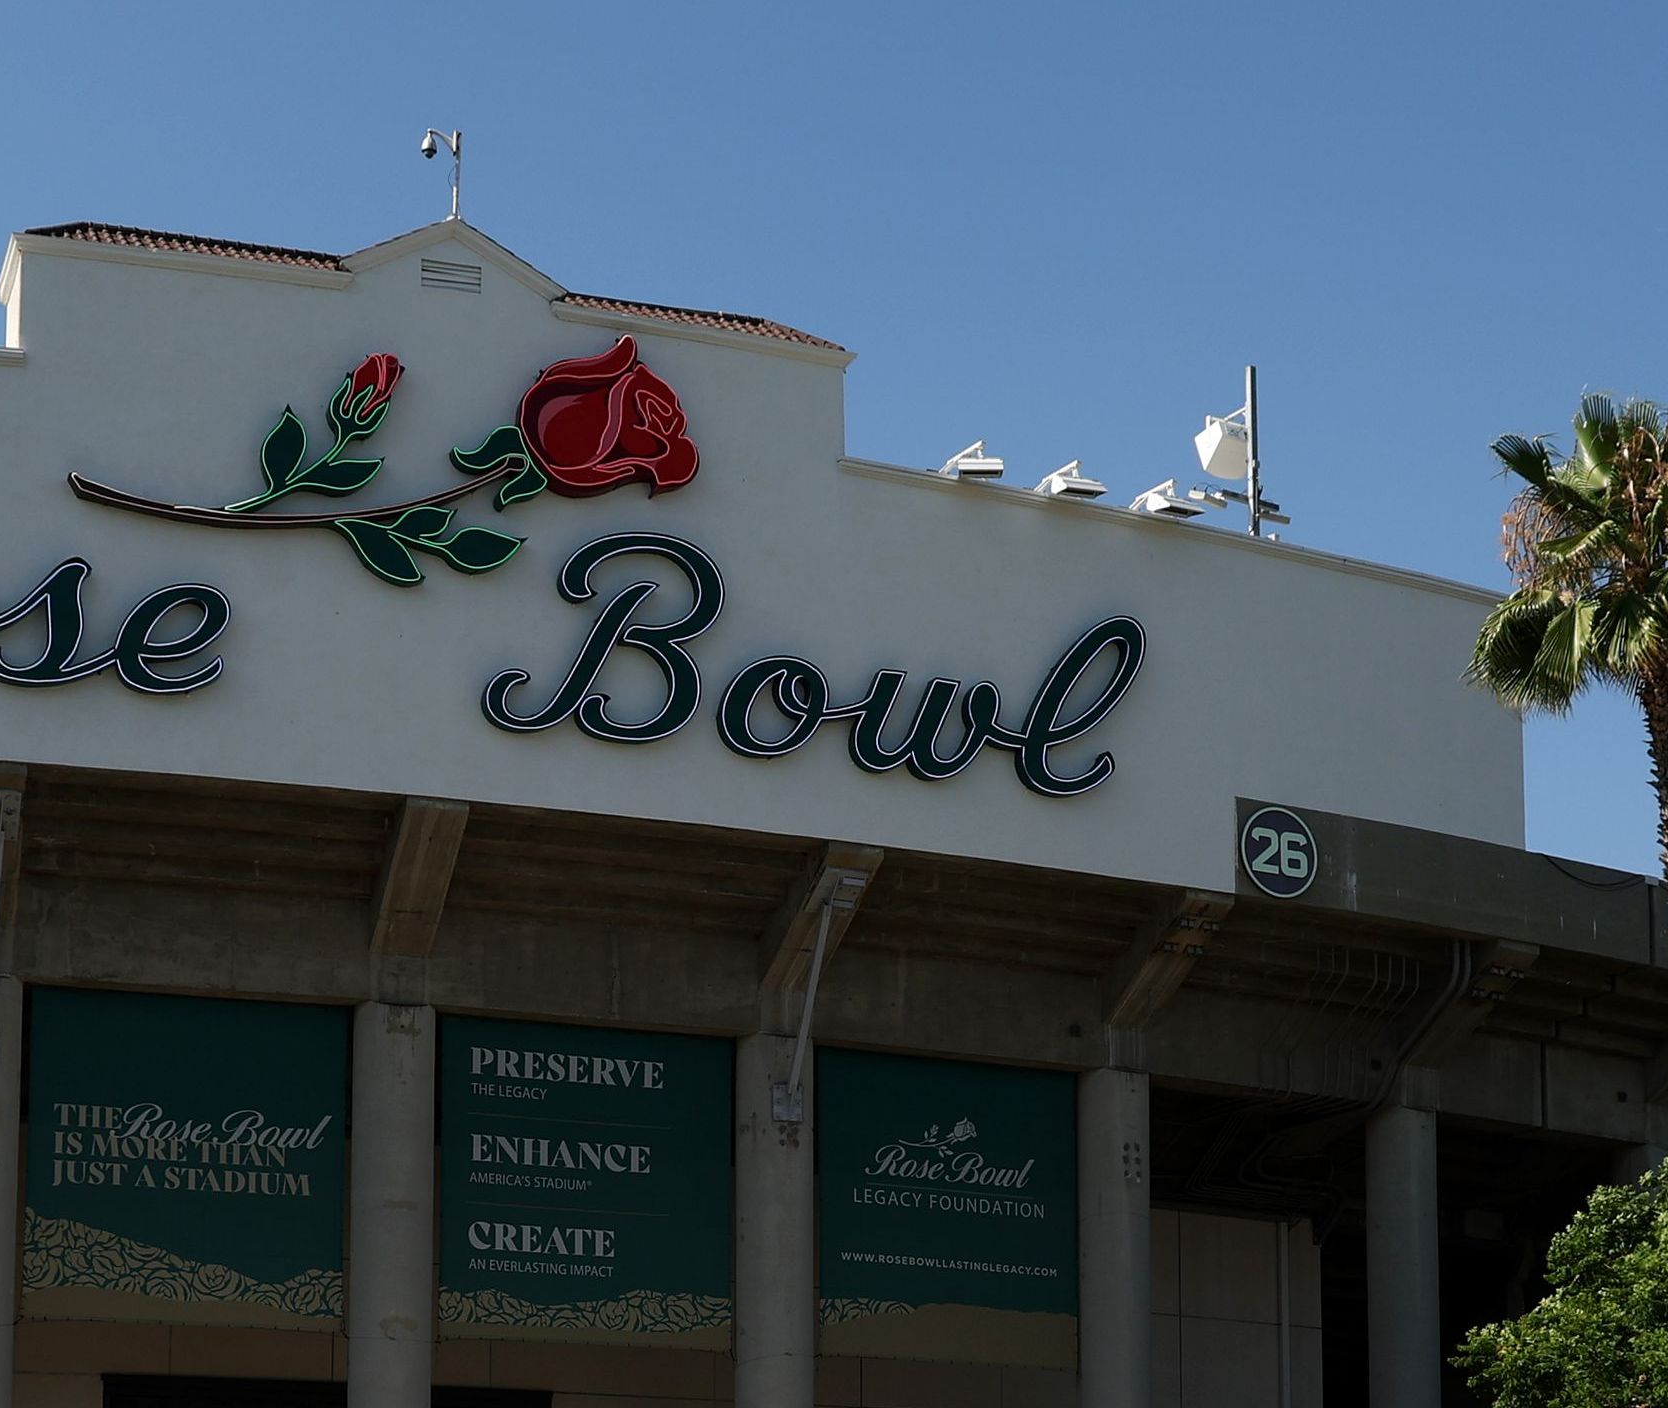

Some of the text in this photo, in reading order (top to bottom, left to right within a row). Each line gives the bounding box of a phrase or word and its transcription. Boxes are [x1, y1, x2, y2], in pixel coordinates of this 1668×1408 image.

[481, 531, 1147, 798] Bowl
[1252, 827, 1308, 878] 26
[470, 1046, 664, 1089] PRESERVE
[471, 1083, 547, 1100] THE LEGACY
[53, 1102, 332, 1150] THE Rose Bowl
[53, 1130, 286, 1168] IS MORE THAN
[470, 1133, 651, 1174] ENHANCE
[865, 1144, 1035, 1189] Rose Bowl
[52, 1159, 311, 1197] JUST A STADIUM
[469, 1172, 531, 1187] AMERICA'S
[853, 1187, 1045, 1219] LEGACY FOUNDATION
[468, 1221, 615, 1258] CREATE
[469, 1258, 614, 1278] AN EVERLASTING IMPACT
[840, 1251, 1059, 1278] WWW.ROSEBOWLLASTINGLEGACY.COM
